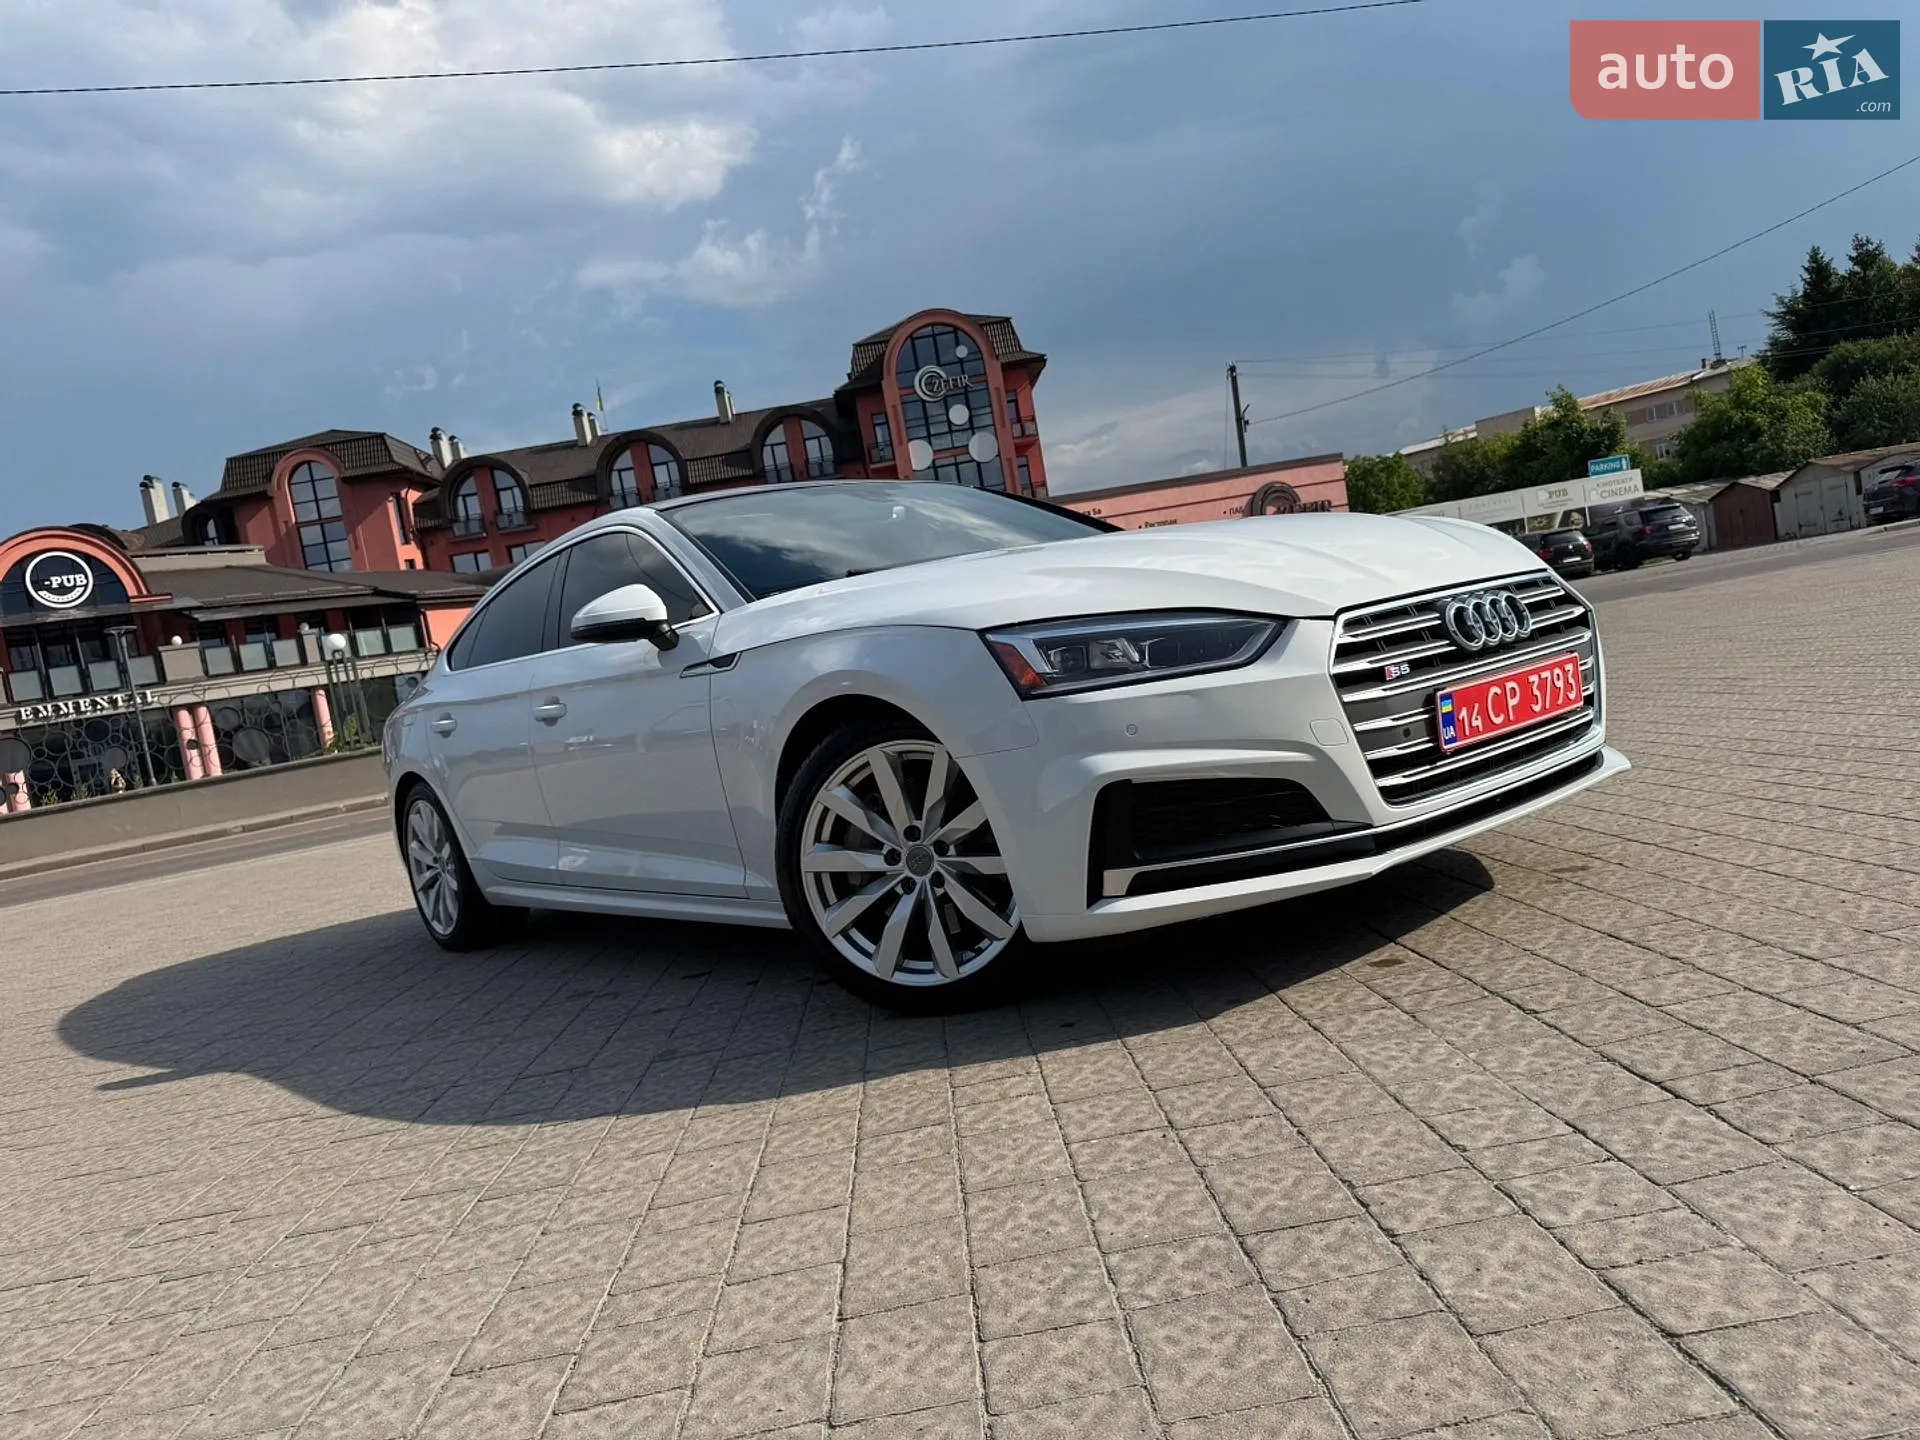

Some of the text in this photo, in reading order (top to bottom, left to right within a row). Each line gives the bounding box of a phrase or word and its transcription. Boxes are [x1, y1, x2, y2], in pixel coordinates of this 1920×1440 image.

[1590, 461, 1621, 473] PARKING
[1548, 487, 1569, 499] PUB
[1600, 484, 1640, 499] CINEMA
[19, 690, 158, 720] EMMENTAL
[1458, 663, 1577, 736] 14 CP 3793
[1443, 725, 1456, 740] UA
